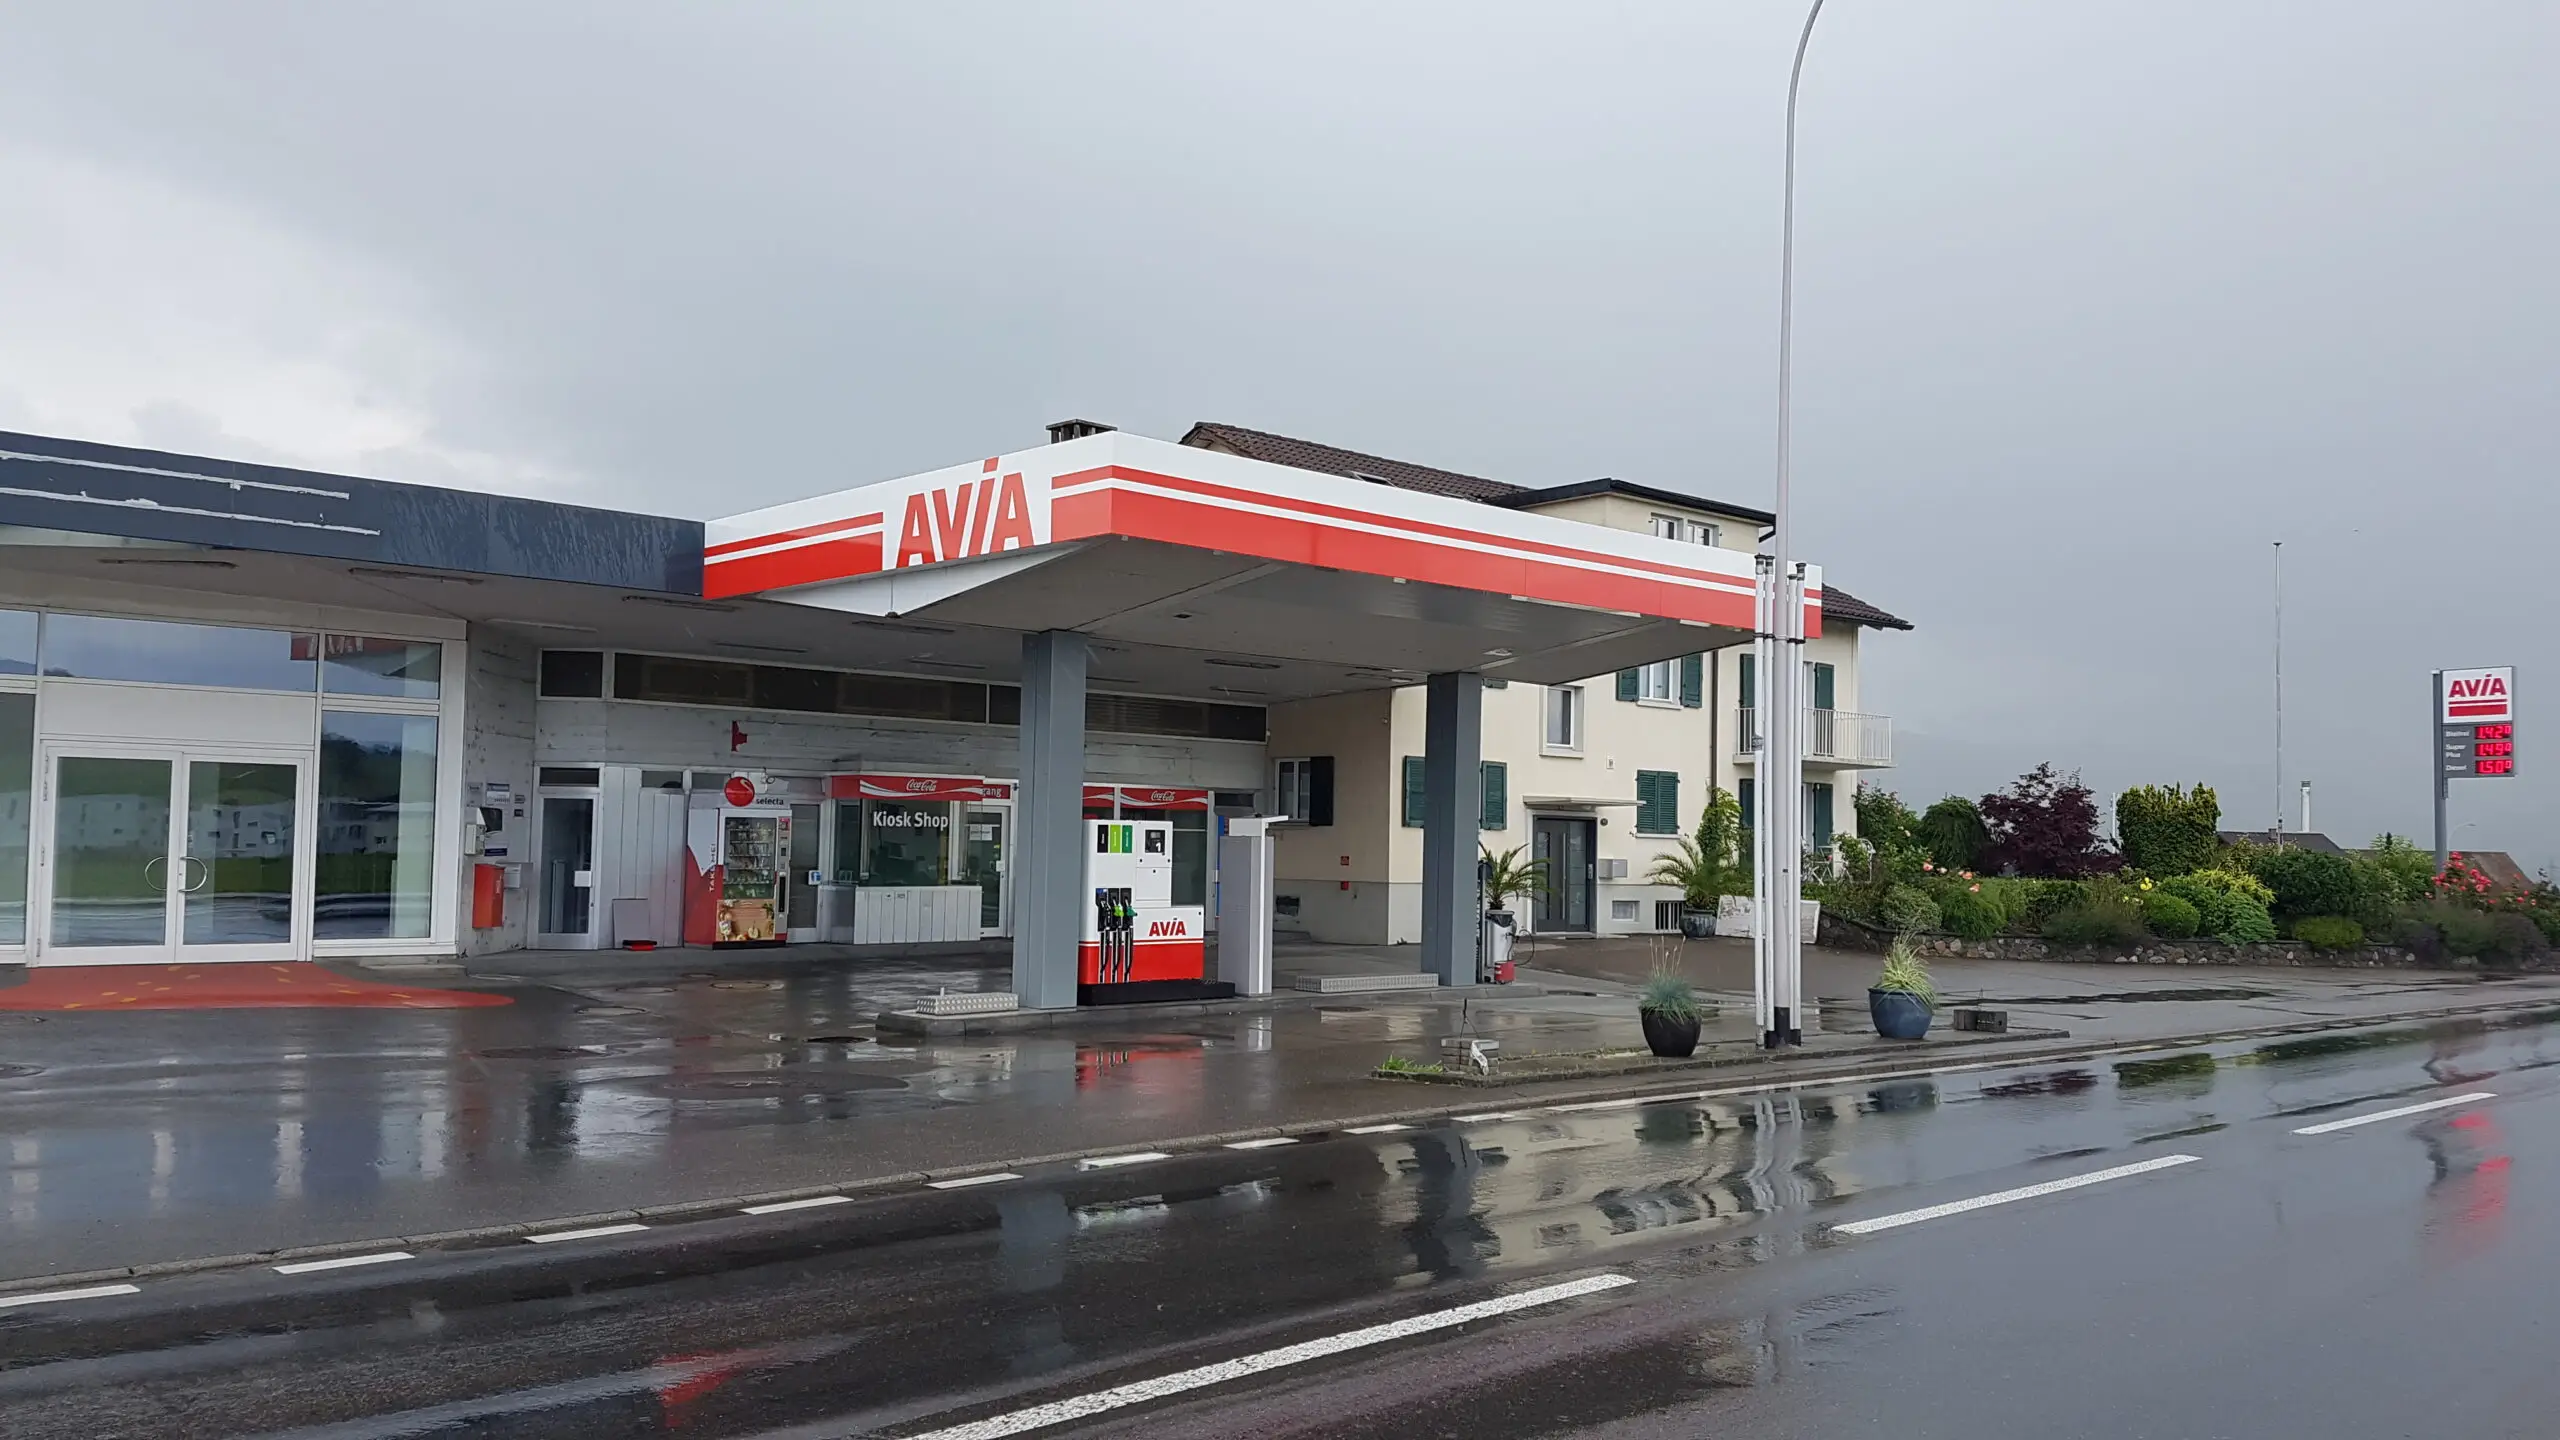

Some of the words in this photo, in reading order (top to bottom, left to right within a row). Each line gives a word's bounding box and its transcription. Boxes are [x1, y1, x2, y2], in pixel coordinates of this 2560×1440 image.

[896, 456, 1035, 569] AVIA
[2448, 674, 2507, 698] AVIA
[755, 797, 784, 805] selecta
[873, 811, 912, 827] Kiosk
[914, 812, 949, 831] Shop
[1155, 842, 1162, 852] 1
[1149, 918, 1186, 936] AVIA
